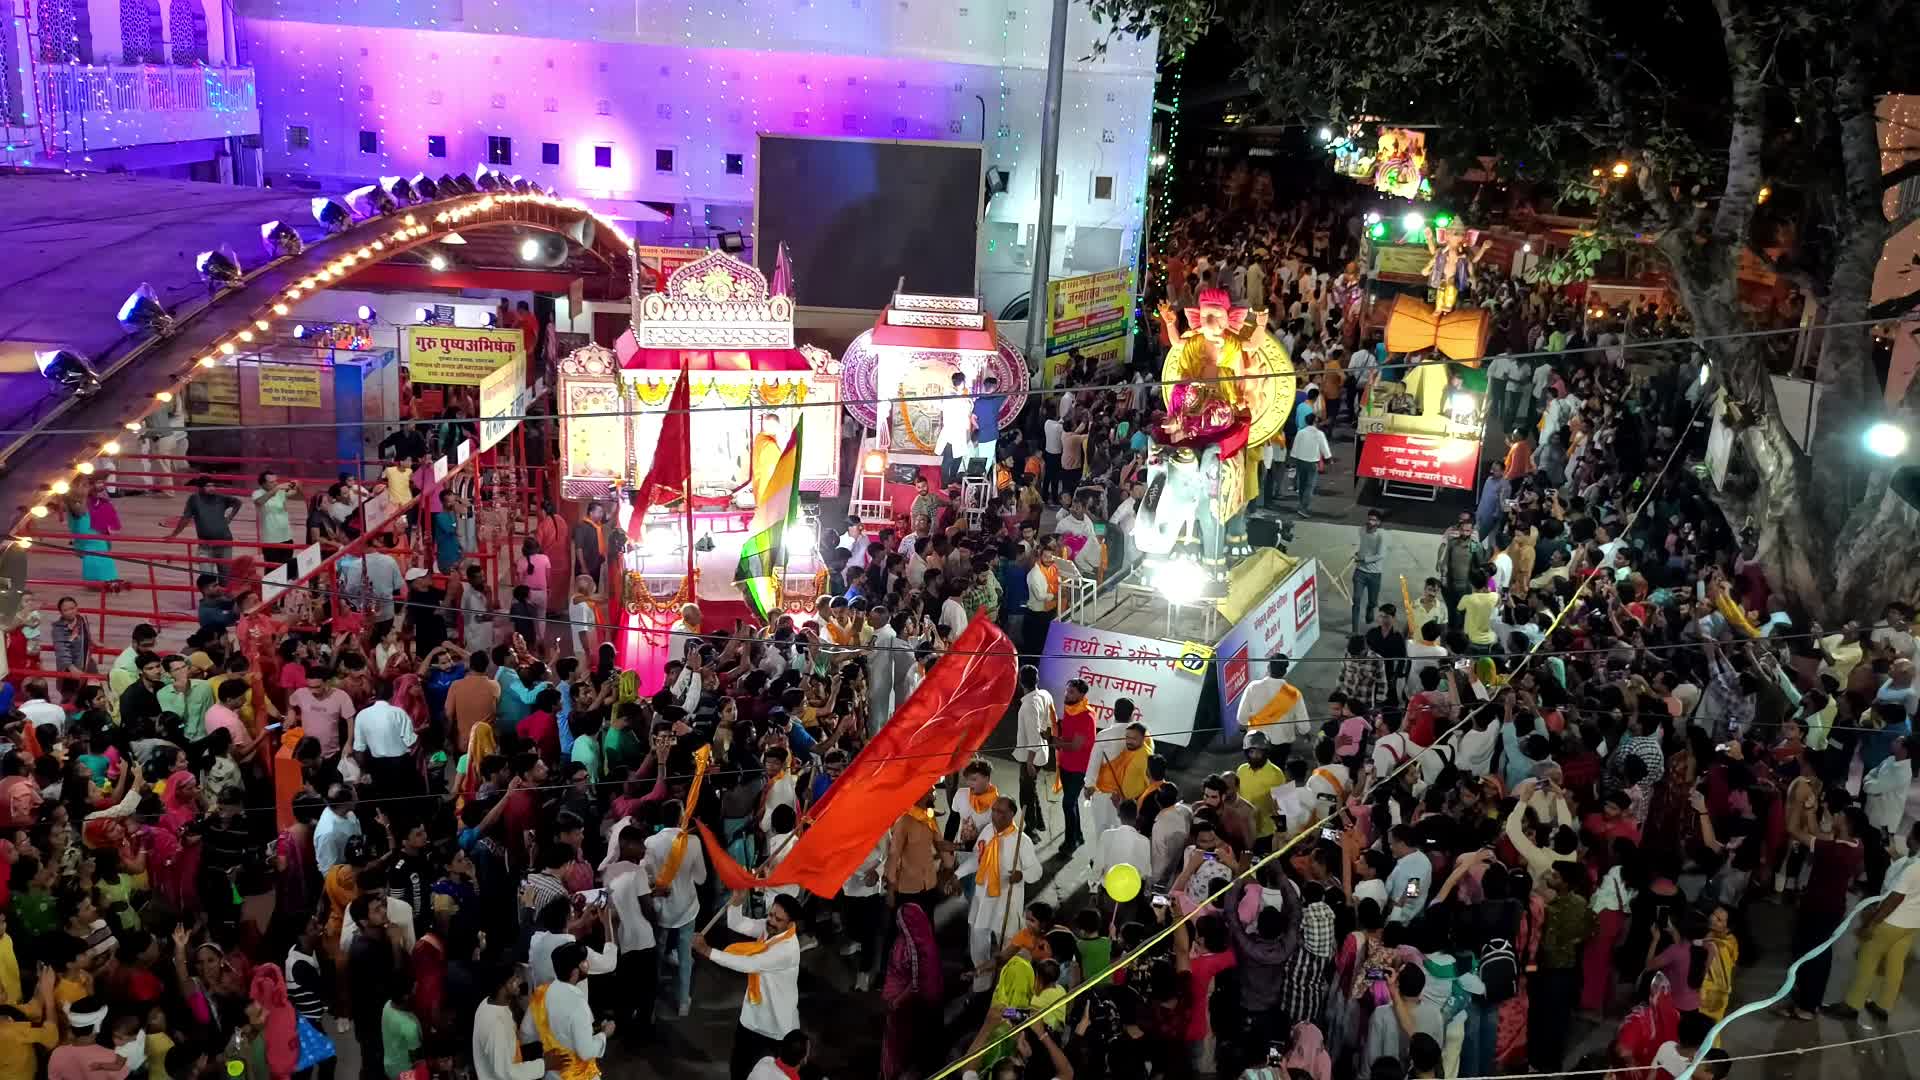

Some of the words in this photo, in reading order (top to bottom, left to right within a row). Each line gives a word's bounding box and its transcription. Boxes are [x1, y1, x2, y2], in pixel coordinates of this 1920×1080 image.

[416, 336, 437, 352] गुरु
[1063, 636, 1100, 655] हाथी
[1104, 640, 1122, 658] के
